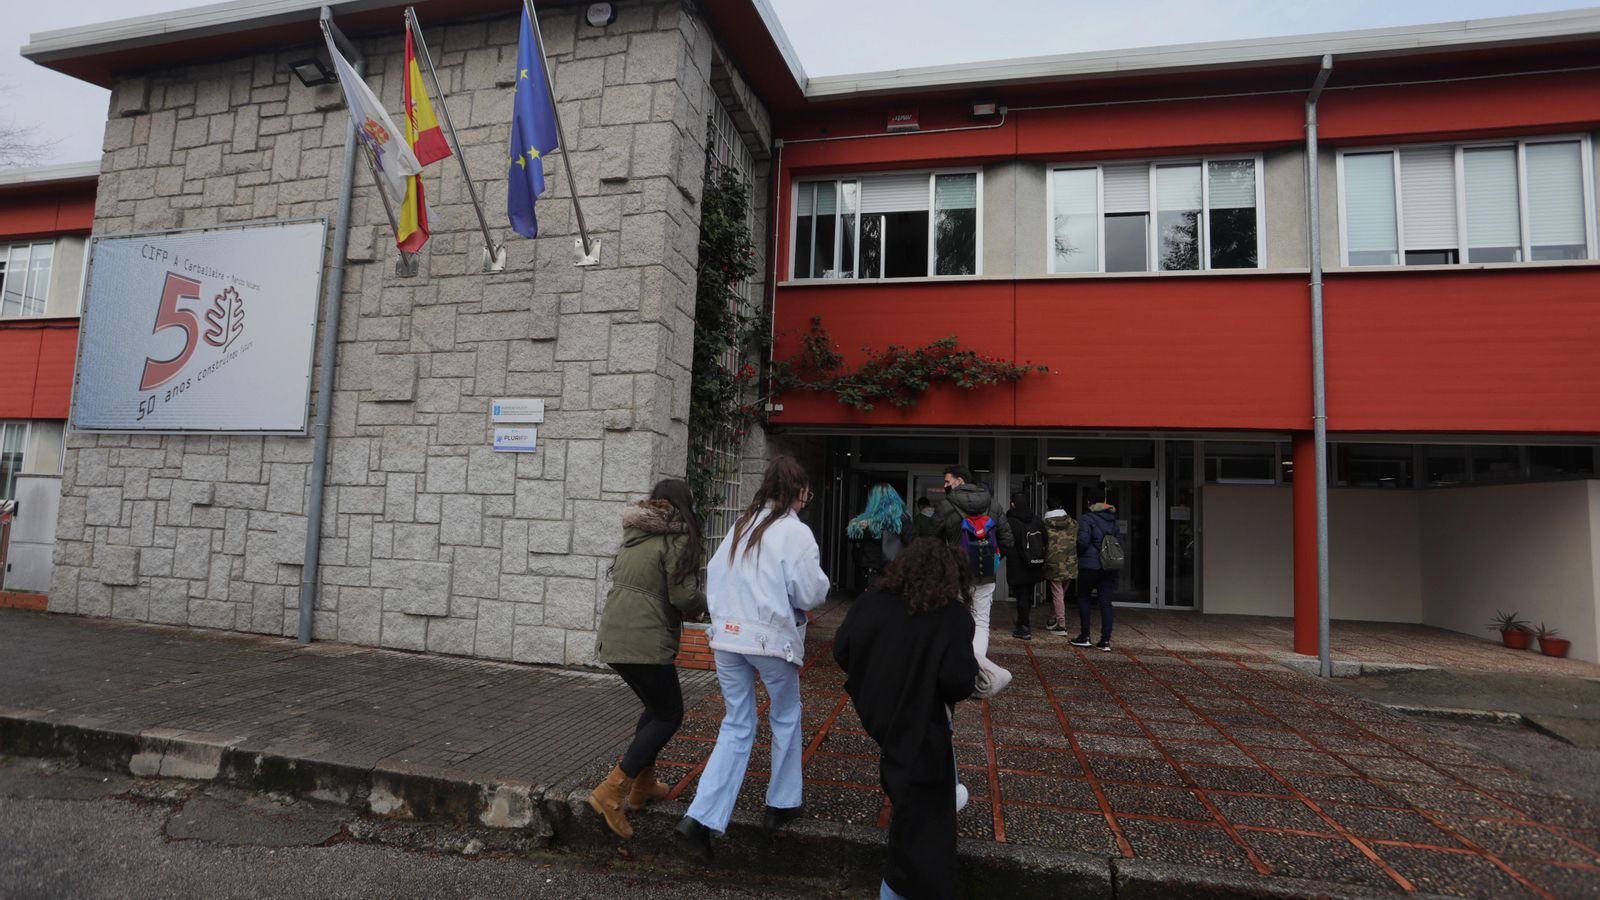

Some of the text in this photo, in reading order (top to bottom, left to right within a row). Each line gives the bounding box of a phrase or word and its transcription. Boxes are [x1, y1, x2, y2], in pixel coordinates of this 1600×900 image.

[141, 243, 169, 263] CIFP
[173, 255, 179, 267] A
[183, 258, 225, 281] Carballeira
[136, 394, 156, 421] 50
[164, 378, 192, 403] anos
